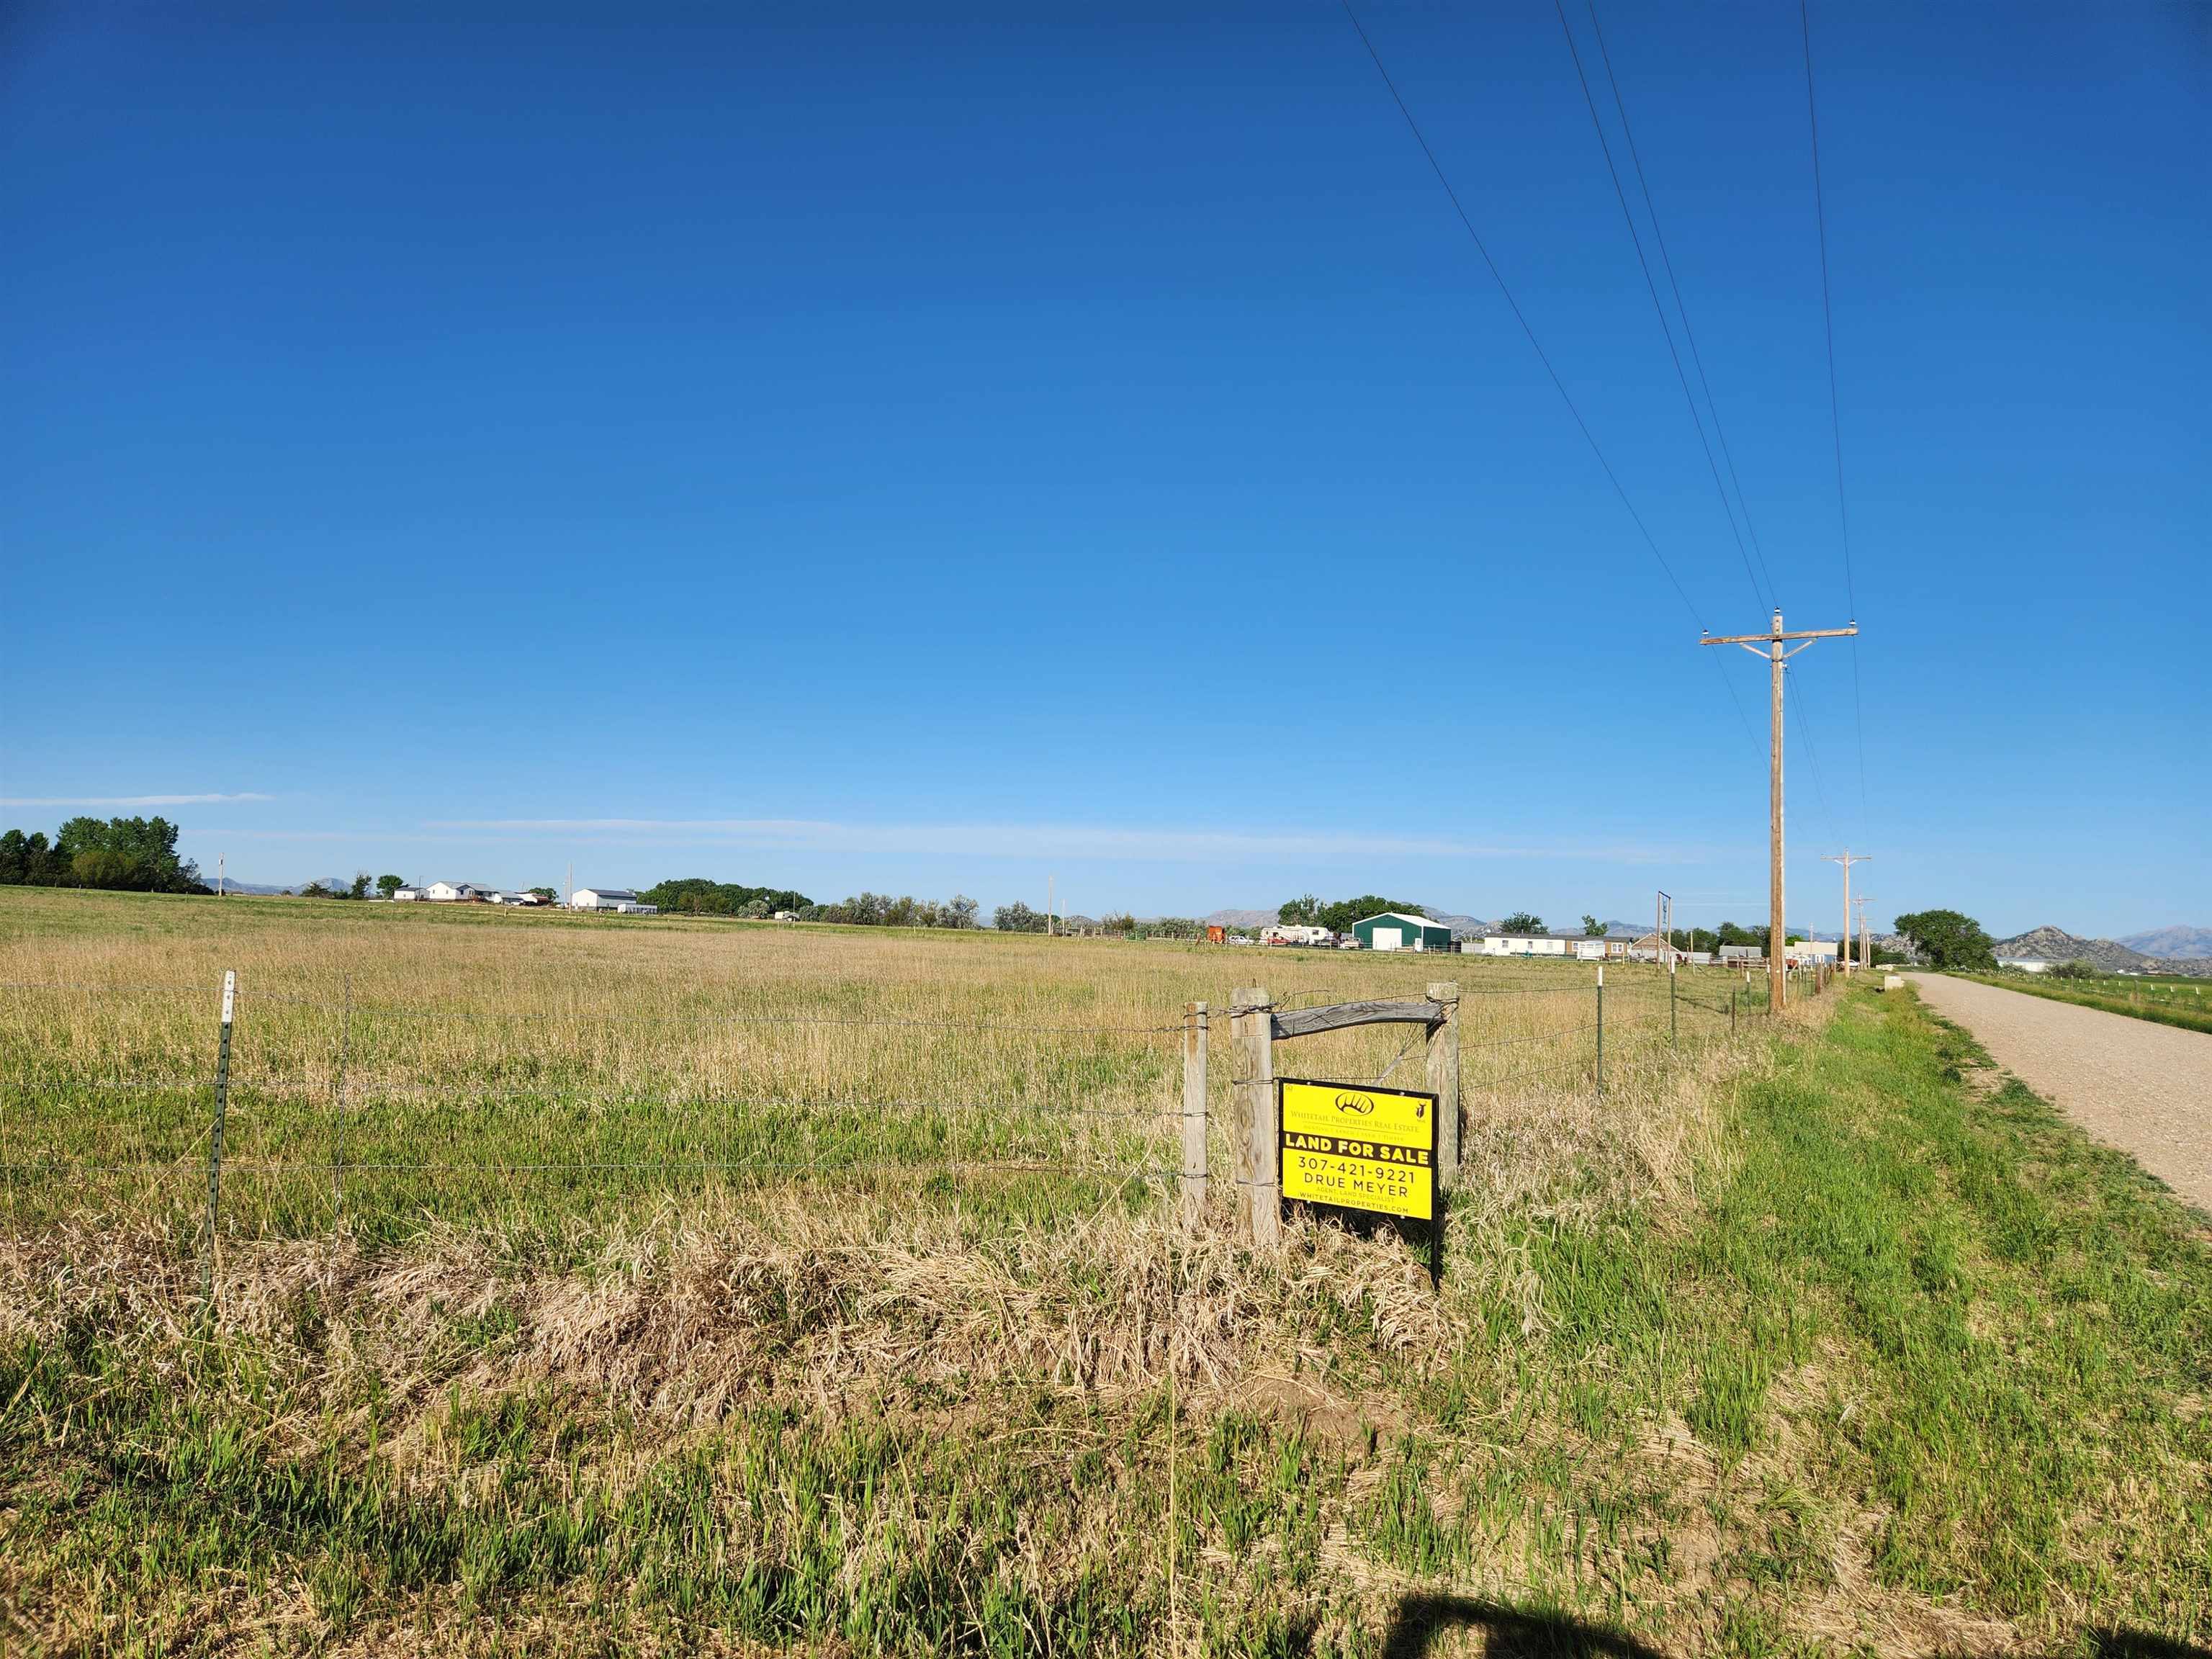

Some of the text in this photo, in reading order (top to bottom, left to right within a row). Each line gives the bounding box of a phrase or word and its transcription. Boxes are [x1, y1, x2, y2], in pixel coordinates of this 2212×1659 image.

[1285, 1134, 1429, 1164] LAND FOR SALE
[1298, 1156, 1415, 1183] 307-421-9221
[1305, 1173, 1408, 1197] DRUE MEYER
[1359, 1192, 1395, 1203] SPECIALIST
